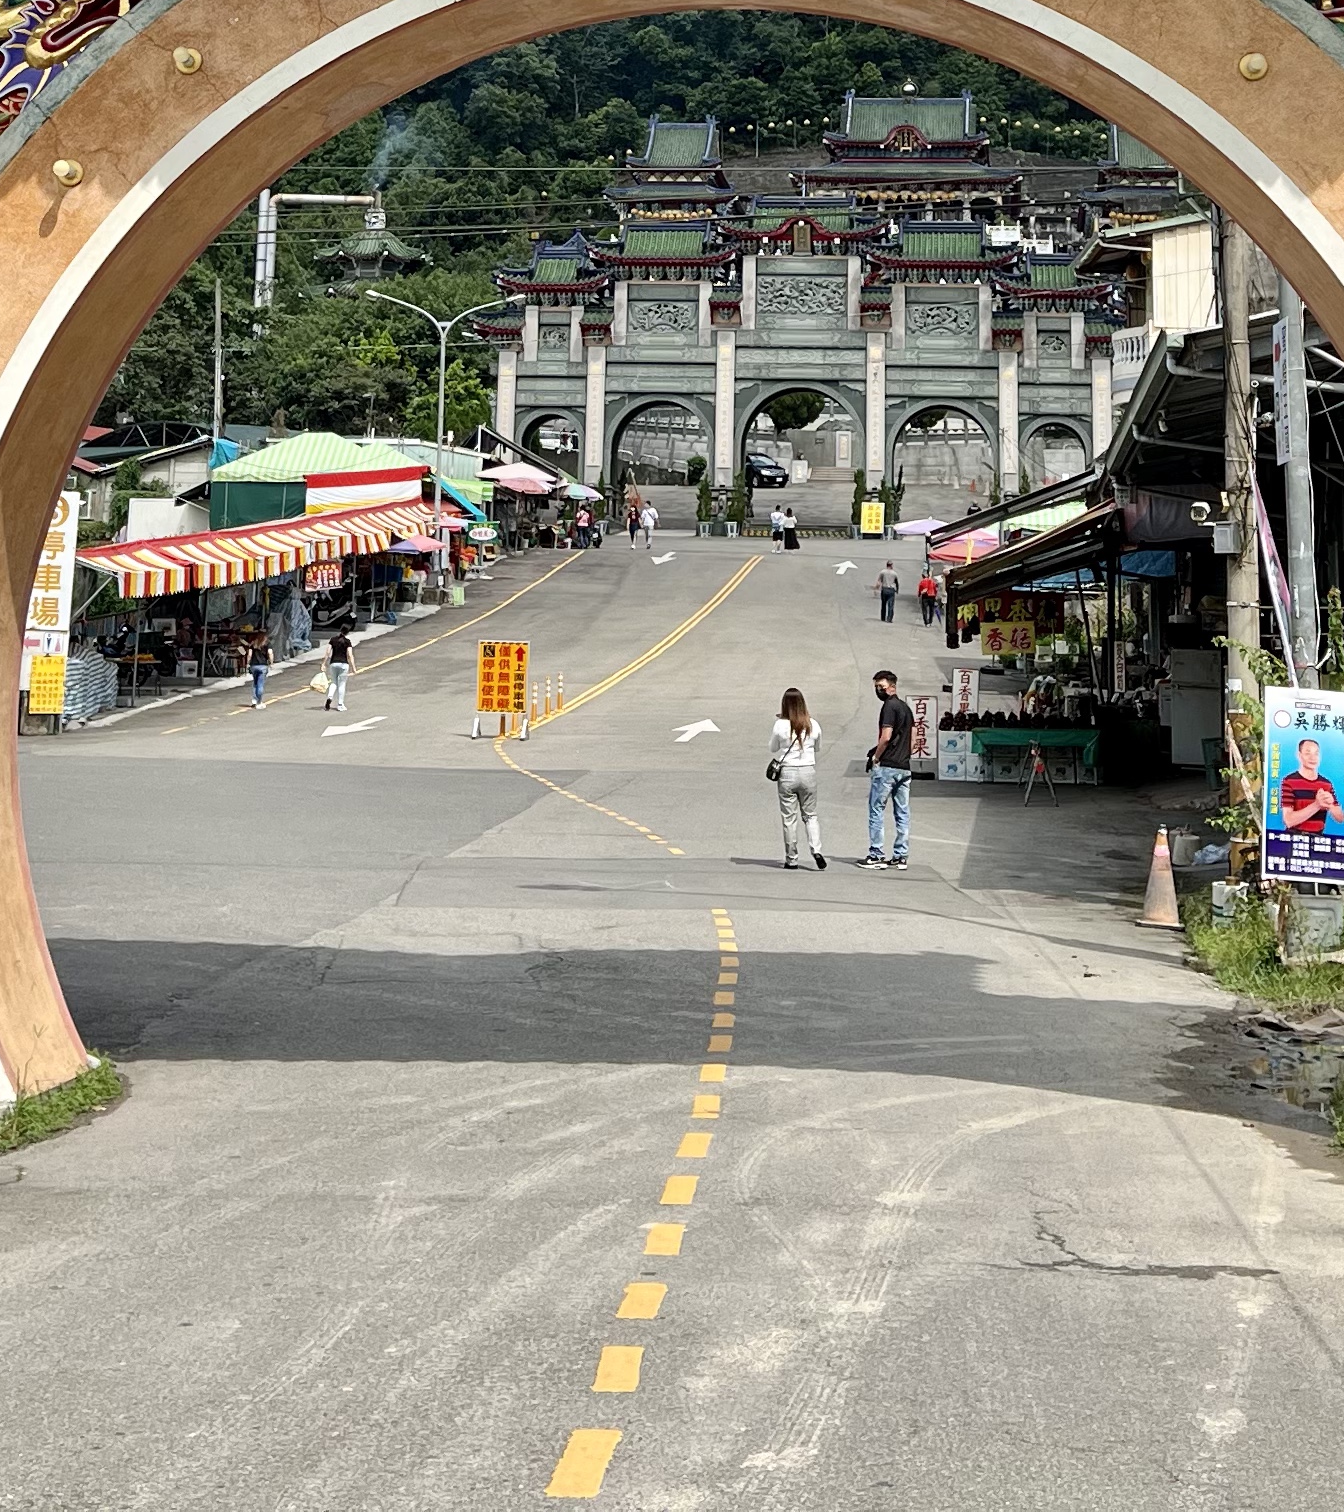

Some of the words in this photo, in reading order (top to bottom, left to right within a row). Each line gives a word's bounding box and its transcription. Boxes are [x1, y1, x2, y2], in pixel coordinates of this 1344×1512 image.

[30, 530, 66, 627] 停車場
[985, 627, 1032, 651] 香菇
[910, 697, 932, 759] 百香果
